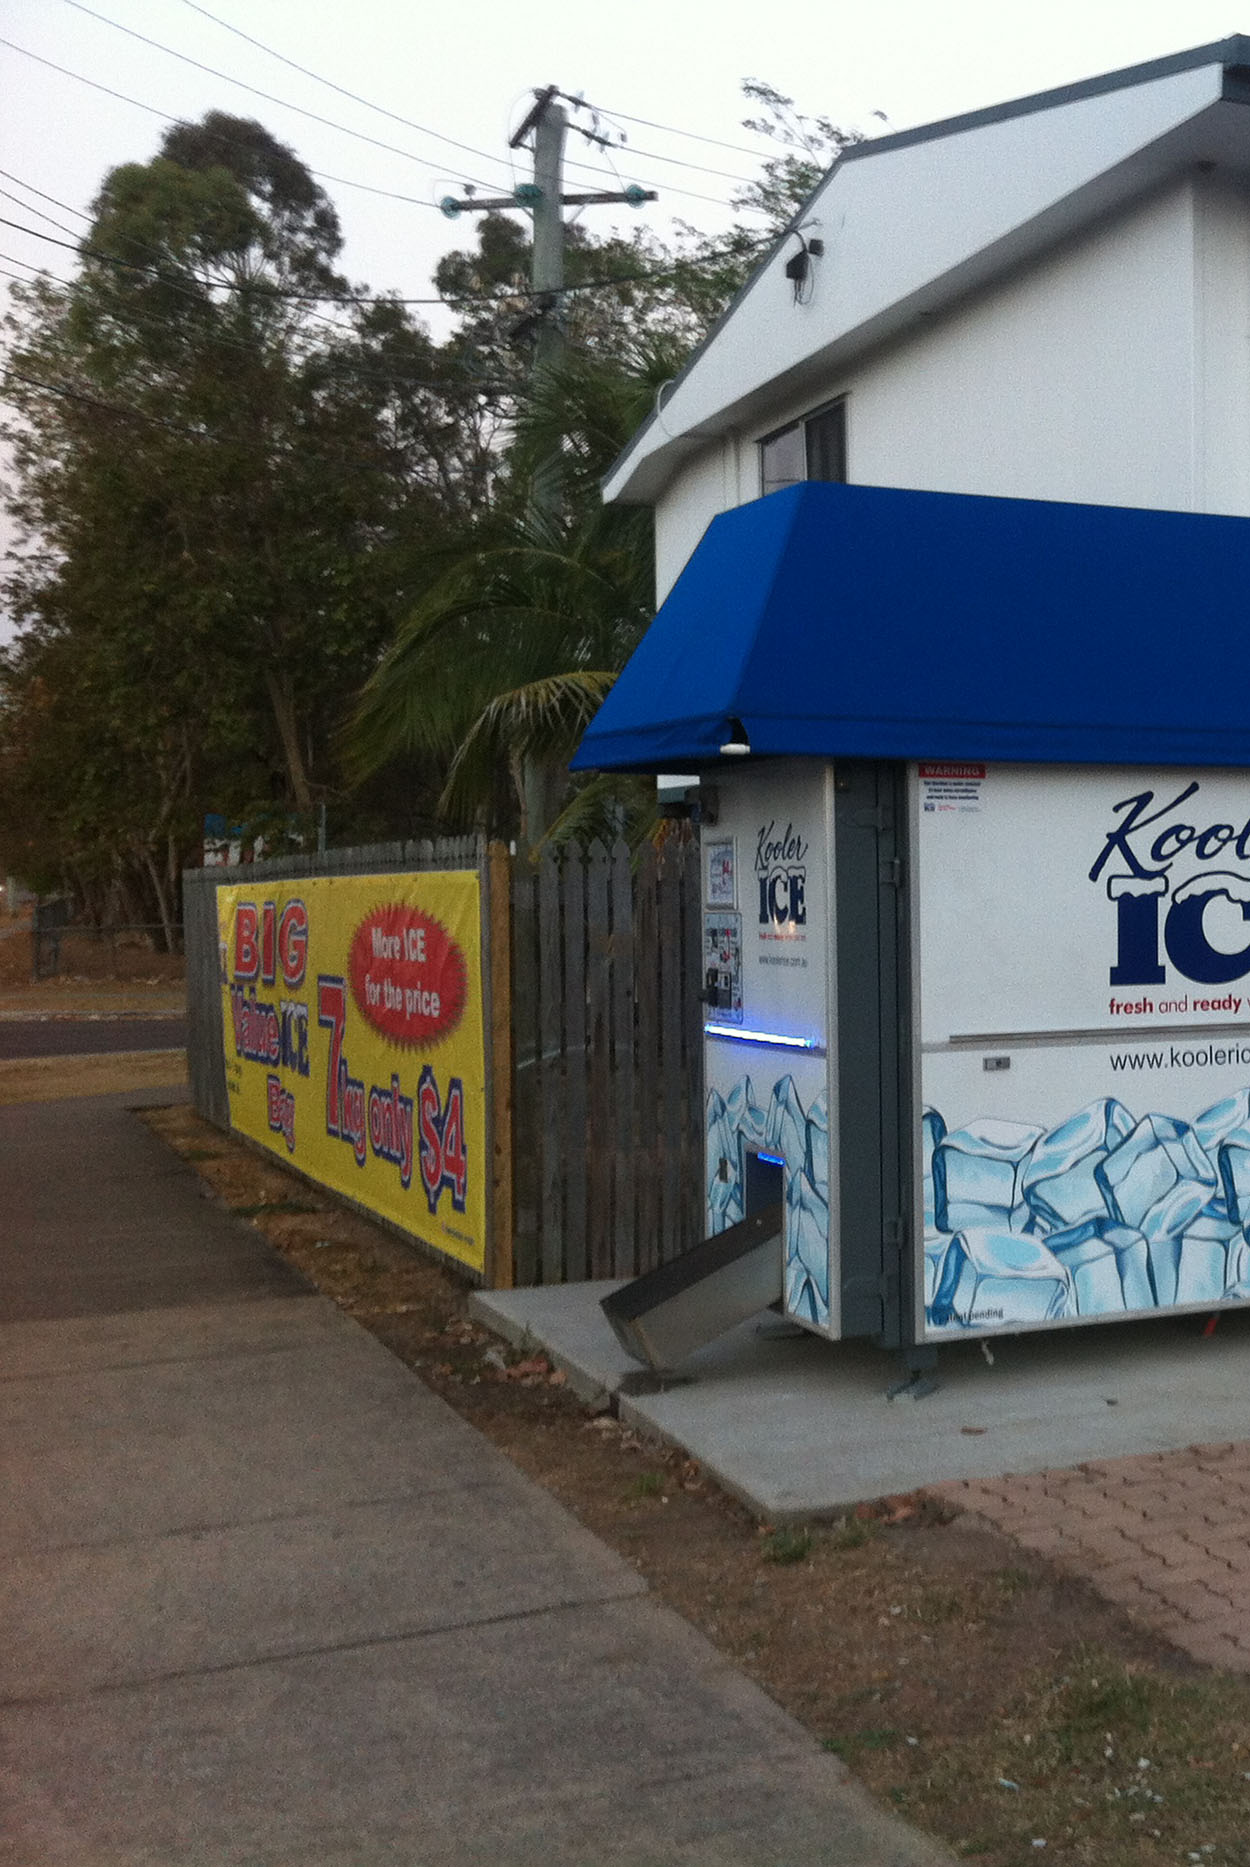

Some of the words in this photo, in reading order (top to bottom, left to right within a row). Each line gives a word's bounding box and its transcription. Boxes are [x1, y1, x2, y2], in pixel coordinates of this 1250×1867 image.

[755, 820, 808, 871] Kooler
[757, 865, 807, 926] ICE
[234, 899, 309, 989] BIG
[371, 926, 401, 960] More
[403, 926, 427, 963] ICE
[364, 973, 381, 1006] for
[383, 978, 403, 1012] the
[404, 980, 441, 1020] price
[1109, 997, 1154, 1015] fresh
[1158, 994, 1188, 1014] and
[1193, 993, 1242, 1014] ready
[280, 1000, 310, 1077] ICE
[368, 1072, 413, 1191] only
[417, 1064, 467, 1214] $4
